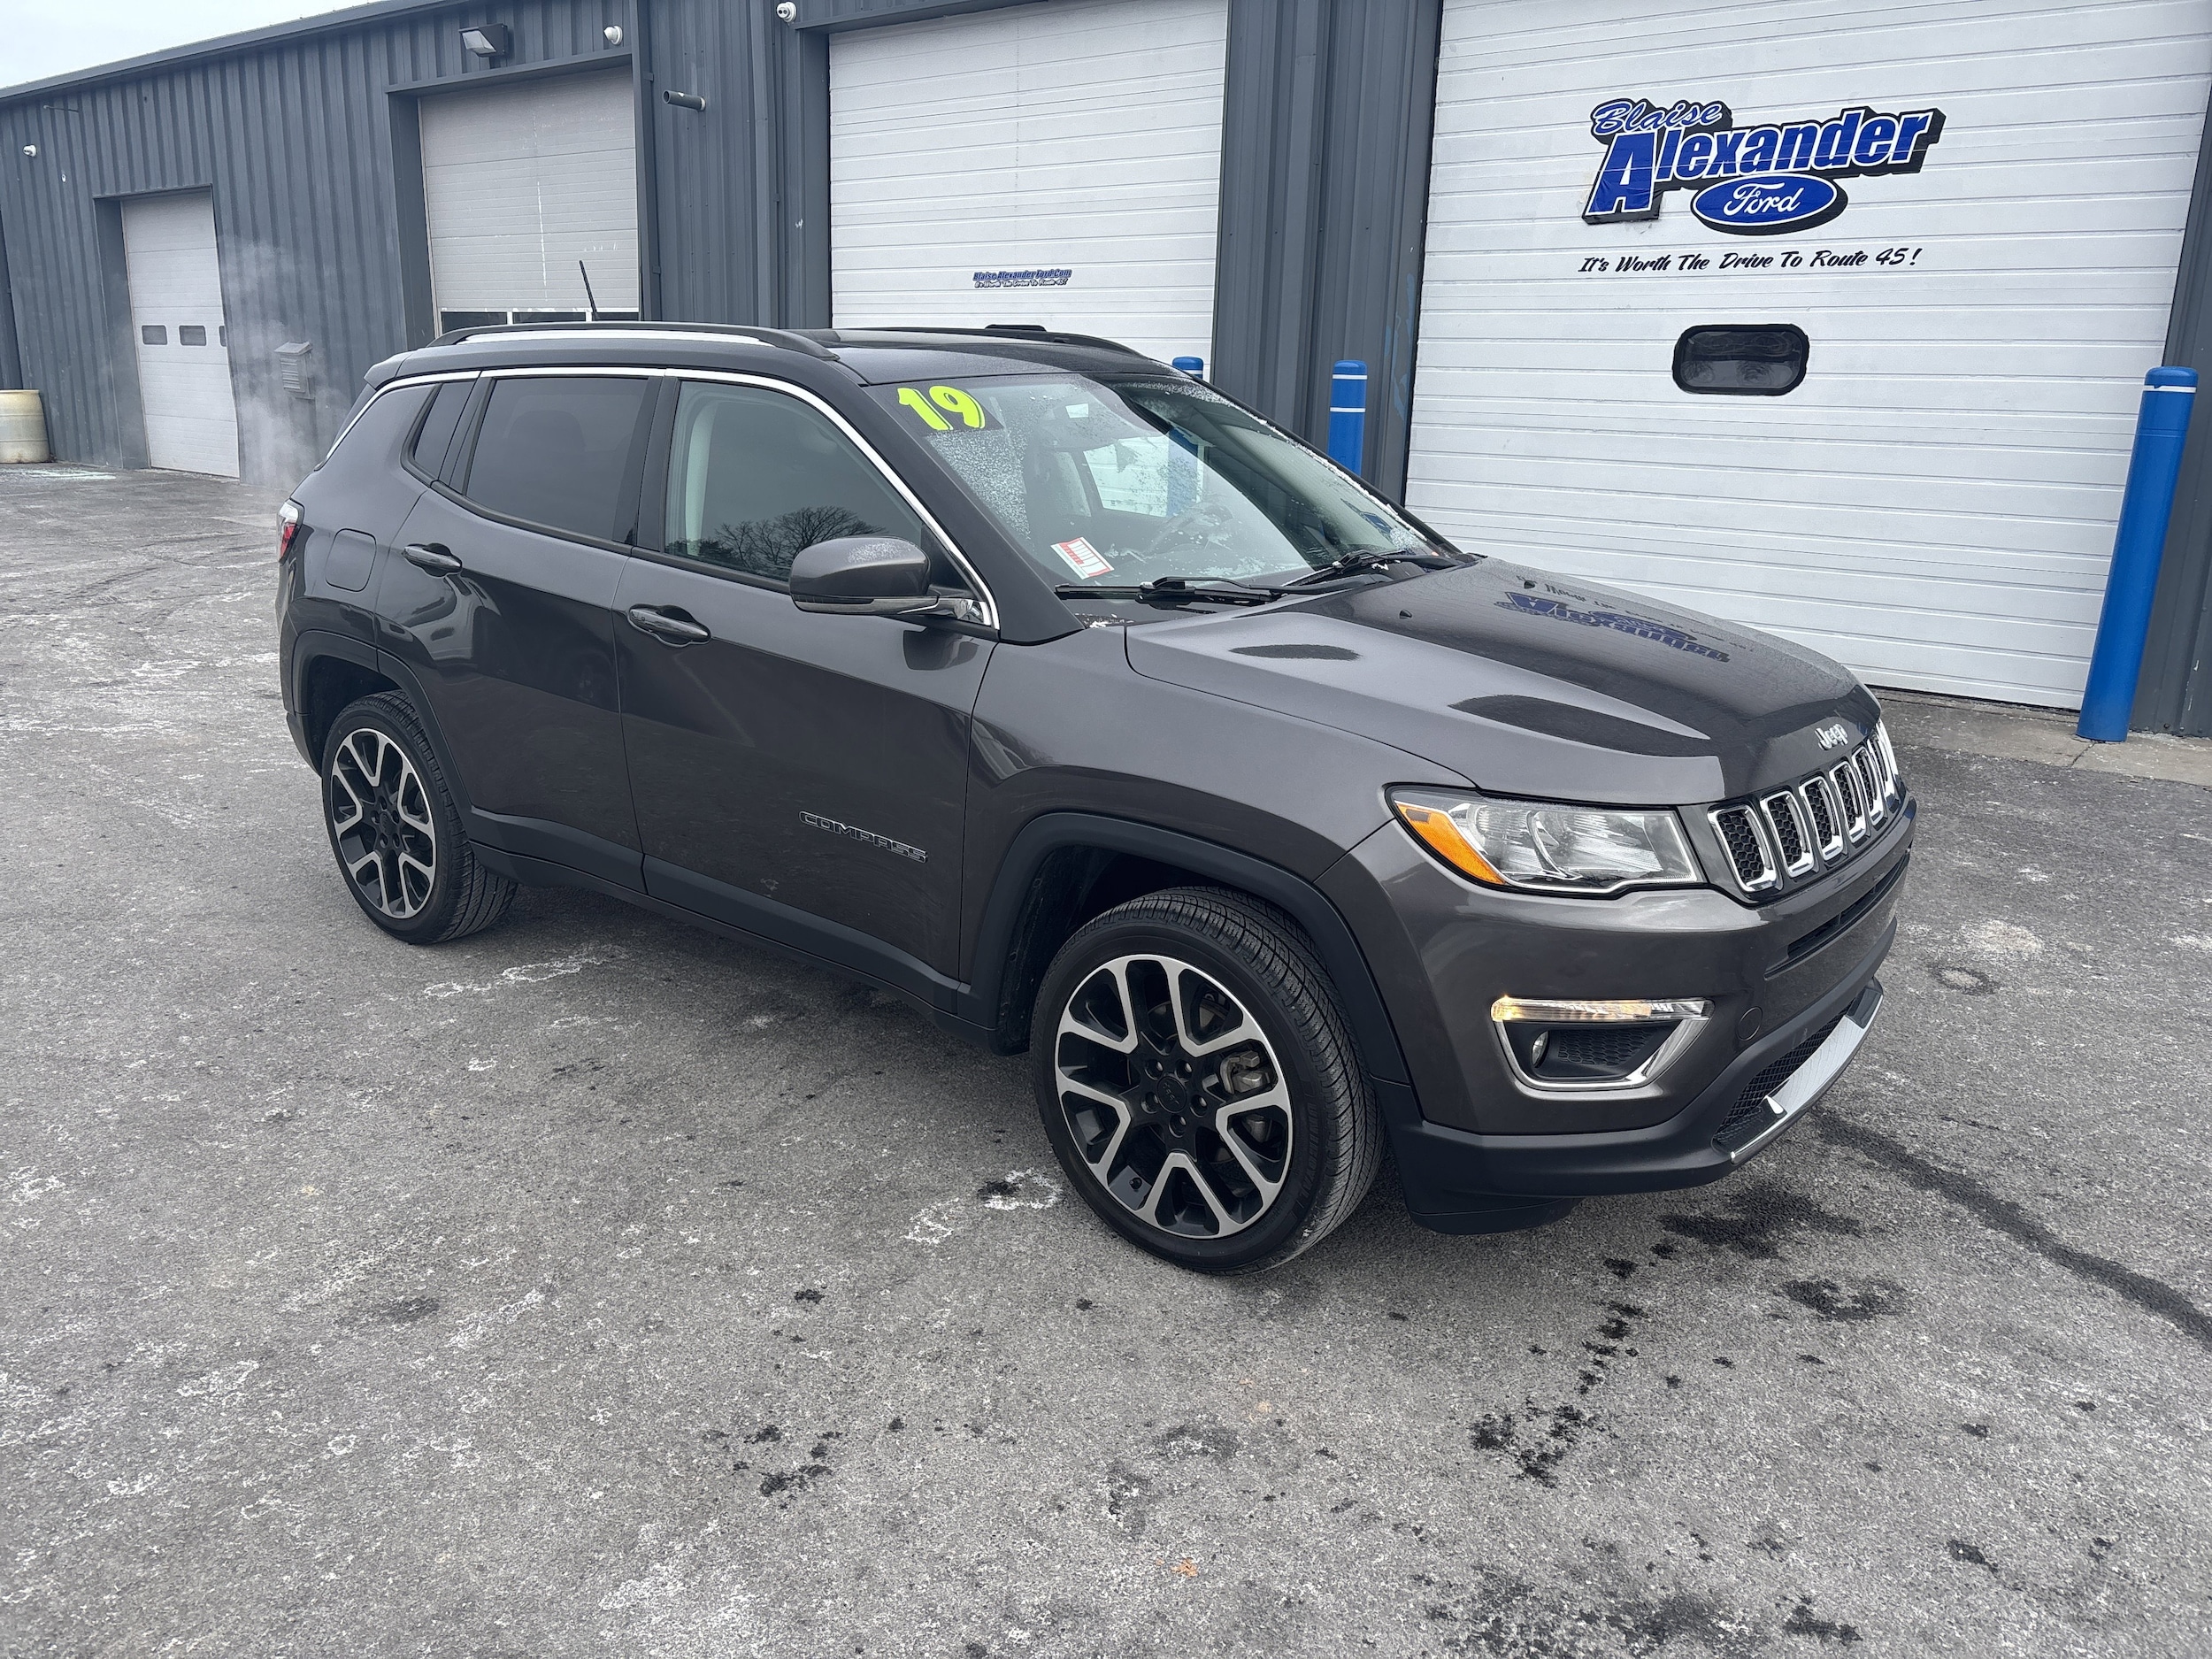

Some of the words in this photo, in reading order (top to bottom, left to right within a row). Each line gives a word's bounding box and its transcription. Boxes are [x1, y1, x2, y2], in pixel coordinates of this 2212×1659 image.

[1592, 99, 1724, 136] Blaise
[1584, 107, 1938, 218] Alexander
[1723, 181, 1805, 217] Ford
[1578, 257, 1609, 273] It's
[1615, 254, 1671, 273] Worth
[1678, 253, 1710, 271] The
[1718, 252, 1774, 270] Drive
[1780, 250, 1803, 268] To
[1809, 250, 1869, 267] Route
[897, 385, 986, 431] 19
[1815, 723, 1848, 750] Jeep
[799, 810, 928, 864] COMPASS
